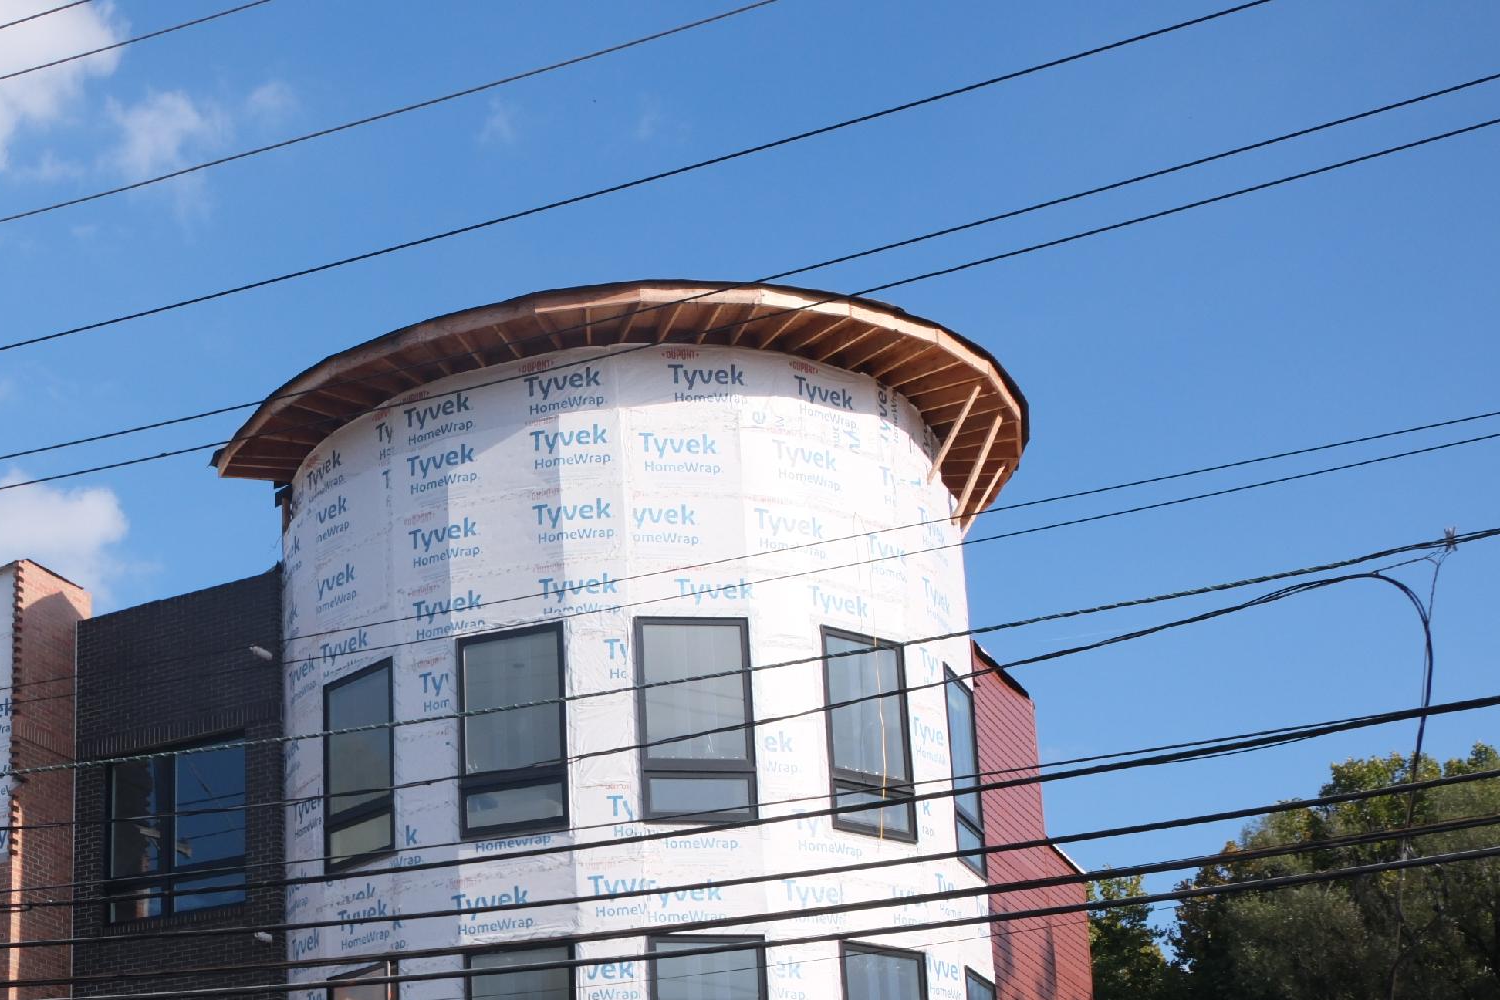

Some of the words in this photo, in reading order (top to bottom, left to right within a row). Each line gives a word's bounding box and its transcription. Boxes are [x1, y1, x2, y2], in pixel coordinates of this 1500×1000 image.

[524, 366, 601, 400] Tyvek
[668, 364, 745, 390] Tyvek
[529, 395, 604, 415] HomeWrap
[674, 392, 748, 406] HomeWrap
[794, 374, 853, 410] Tyvek
[404, 392, 470, 430] Tyvek
[800, 405, 857, 430] HomeWrap
[408, 419, 474, 445] HomeWrap
[530, 424, 607, 454] Tyvek
[638, 432, 717, 458] Tyvek
[407, 444, 474, 479] Tyvek
[535, 452, 611, 469] HomeWrap
[645, 460, 721, 474] HomeWrap
[772, 439, 837, 471] Tyvek
[306, 450, 341, 491] Tyvek
[410, 471, 477, 495] HomeWrap
[532, 498, 611, 529] Tyvek
[632, 504, 696, 529] yvek
[754, 508, 823, 539] Tyvek
[408, 516, 477, 552] Tyvek
[538, 528, 614, 544] HomeWrap
[633, 532, 700, 546] omeWrap
[413, 546, 480, 569] HomeWrap
[538, 573, 618, 603] Tyvek
[674, 576, 754, 606] Tyvek
[412, 590, 482, 625] Tyvek
[807, 585, 868, 618] Tyvek
[416, 618, 485, 640] HomeWrap
[320, 628, 368, 666] Tyvek
[764, 730, 793, 752] ek
[405, 825, 417, 846] k
[475, 834, 552, 853] HomeWrap
[798, 839, 862, 857] HomeWrap
[451, 885, 529, 921] Tyvek
[338, 900, 388, 935] Tyvek
[458, 917, 534, 935] HomeWrap
[341, 929, 390, 951] HomeWrap
